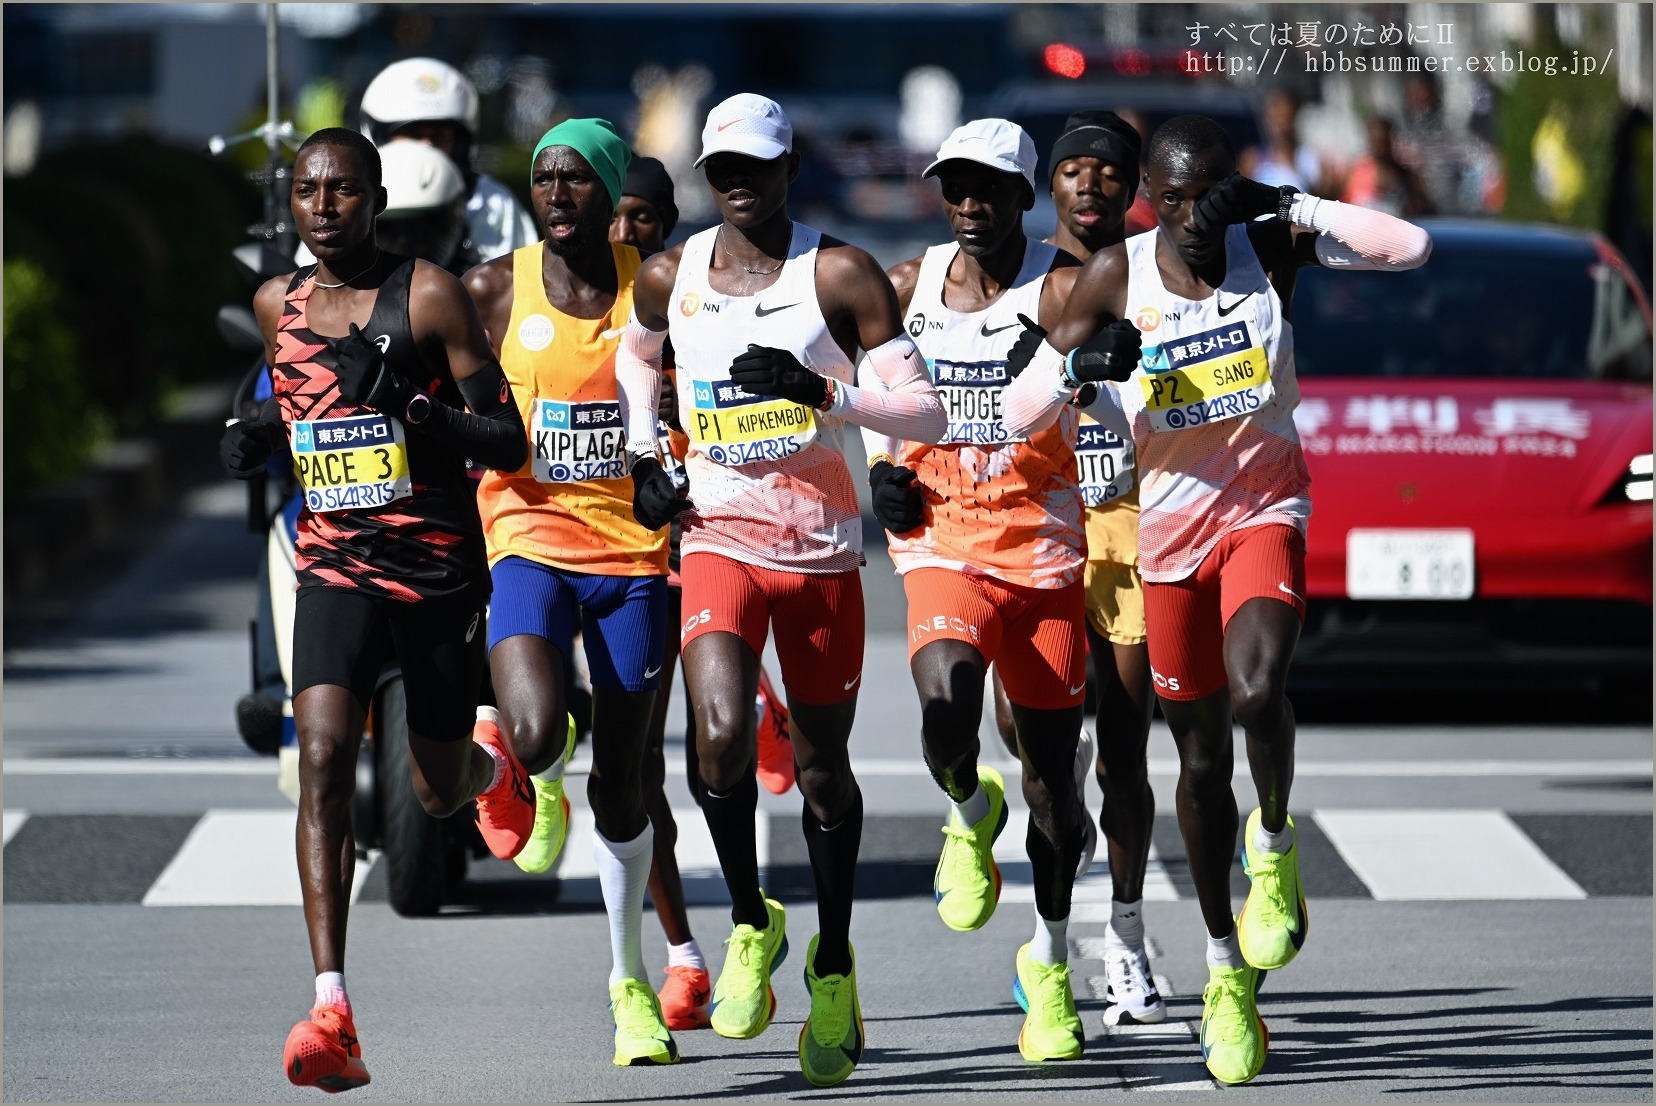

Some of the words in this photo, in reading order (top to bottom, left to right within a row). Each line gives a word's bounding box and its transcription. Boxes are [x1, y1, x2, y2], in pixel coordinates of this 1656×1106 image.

[703, 302, 720, 314] NN
[1165, 312, 1181, 322] NN
[928, 321, 944, 331] NN
[1171, 330, 1245, 362] 東京メトロ
[938, 366, 1007, 381] 東京メトロ
[1150, 376, 1184, 407] P2
[1213, 360, 1254, 387] SANG
[737, 405, 808, 434] KIPKEMBOI
[318, 424, 388, 443] 東京メトロ
[1076, 430, 1118, 446] メトロ
[299, 452, 358, 486] PACE
[373, 448, 393, 480] 3
[912, 616, 978, 643] INEOS
